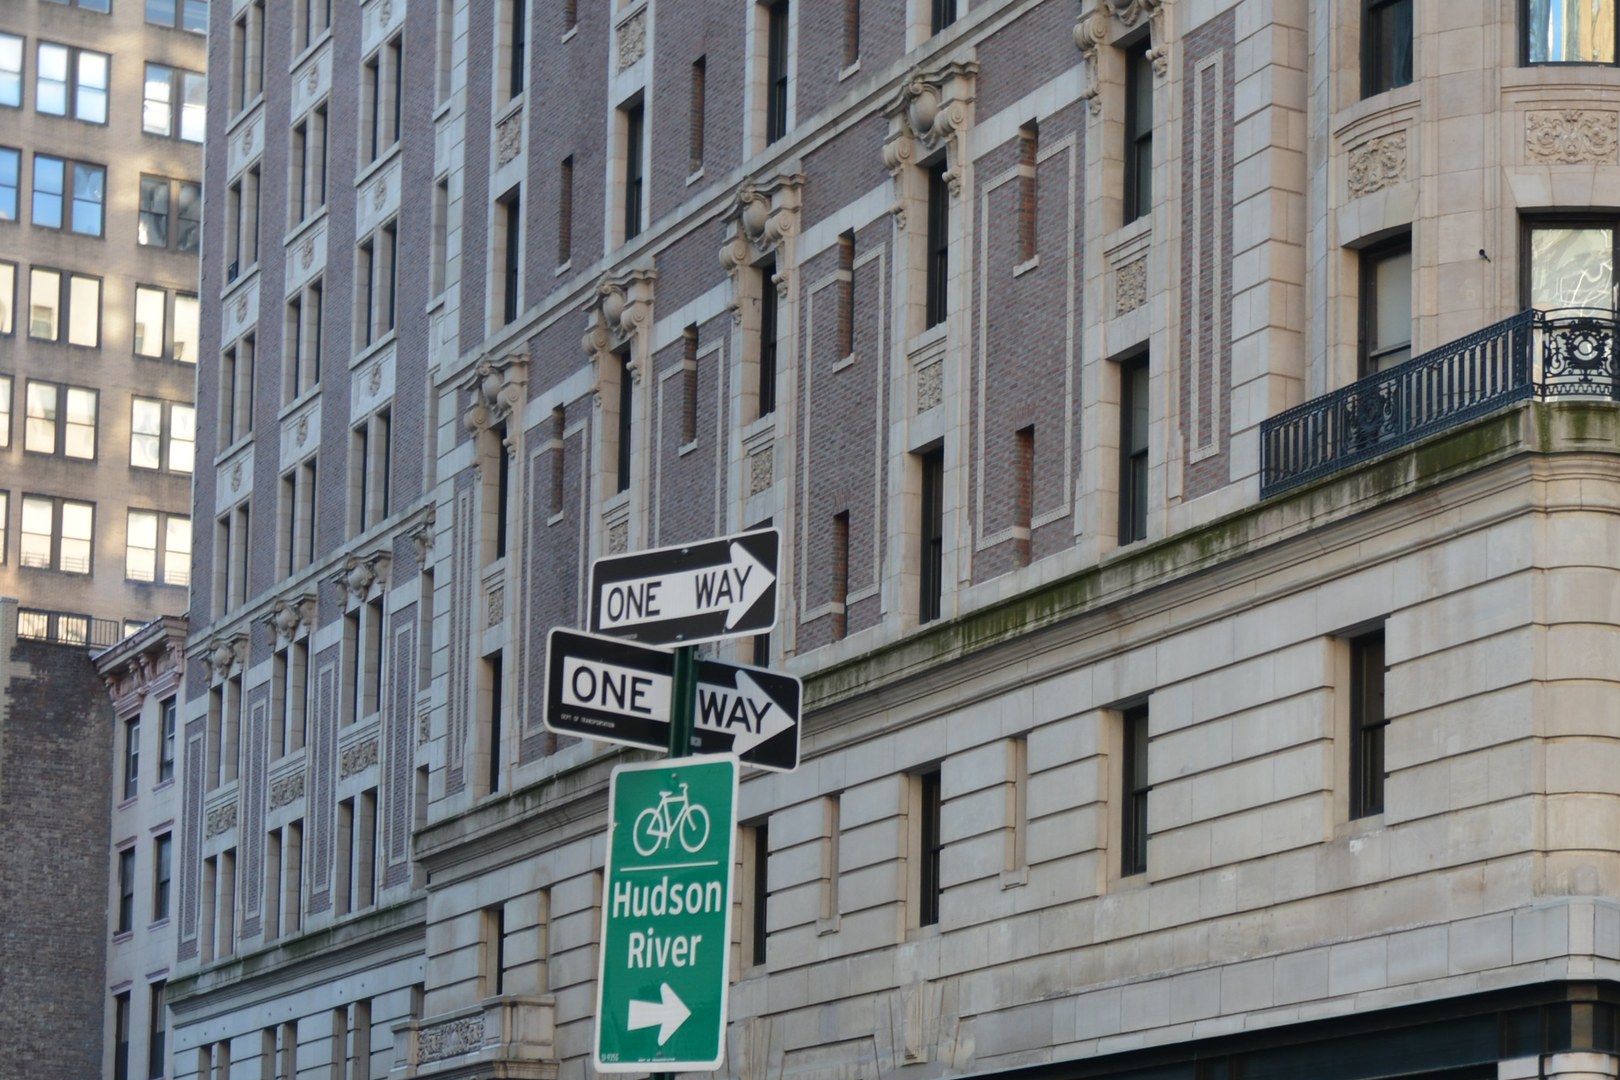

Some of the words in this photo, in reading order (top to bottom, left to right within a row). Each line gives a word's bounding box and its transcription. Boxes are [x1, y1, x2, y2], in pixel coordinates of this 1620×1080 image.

[607, 581, 662, 622] ONE
[695, 565, 753, 609] WAY
[572, 666, 652, 714] ONE
[699, 690, 772, 734] WAY
[613, 876, 722, 918] Hudson
[627, 927, 702, 969] River
